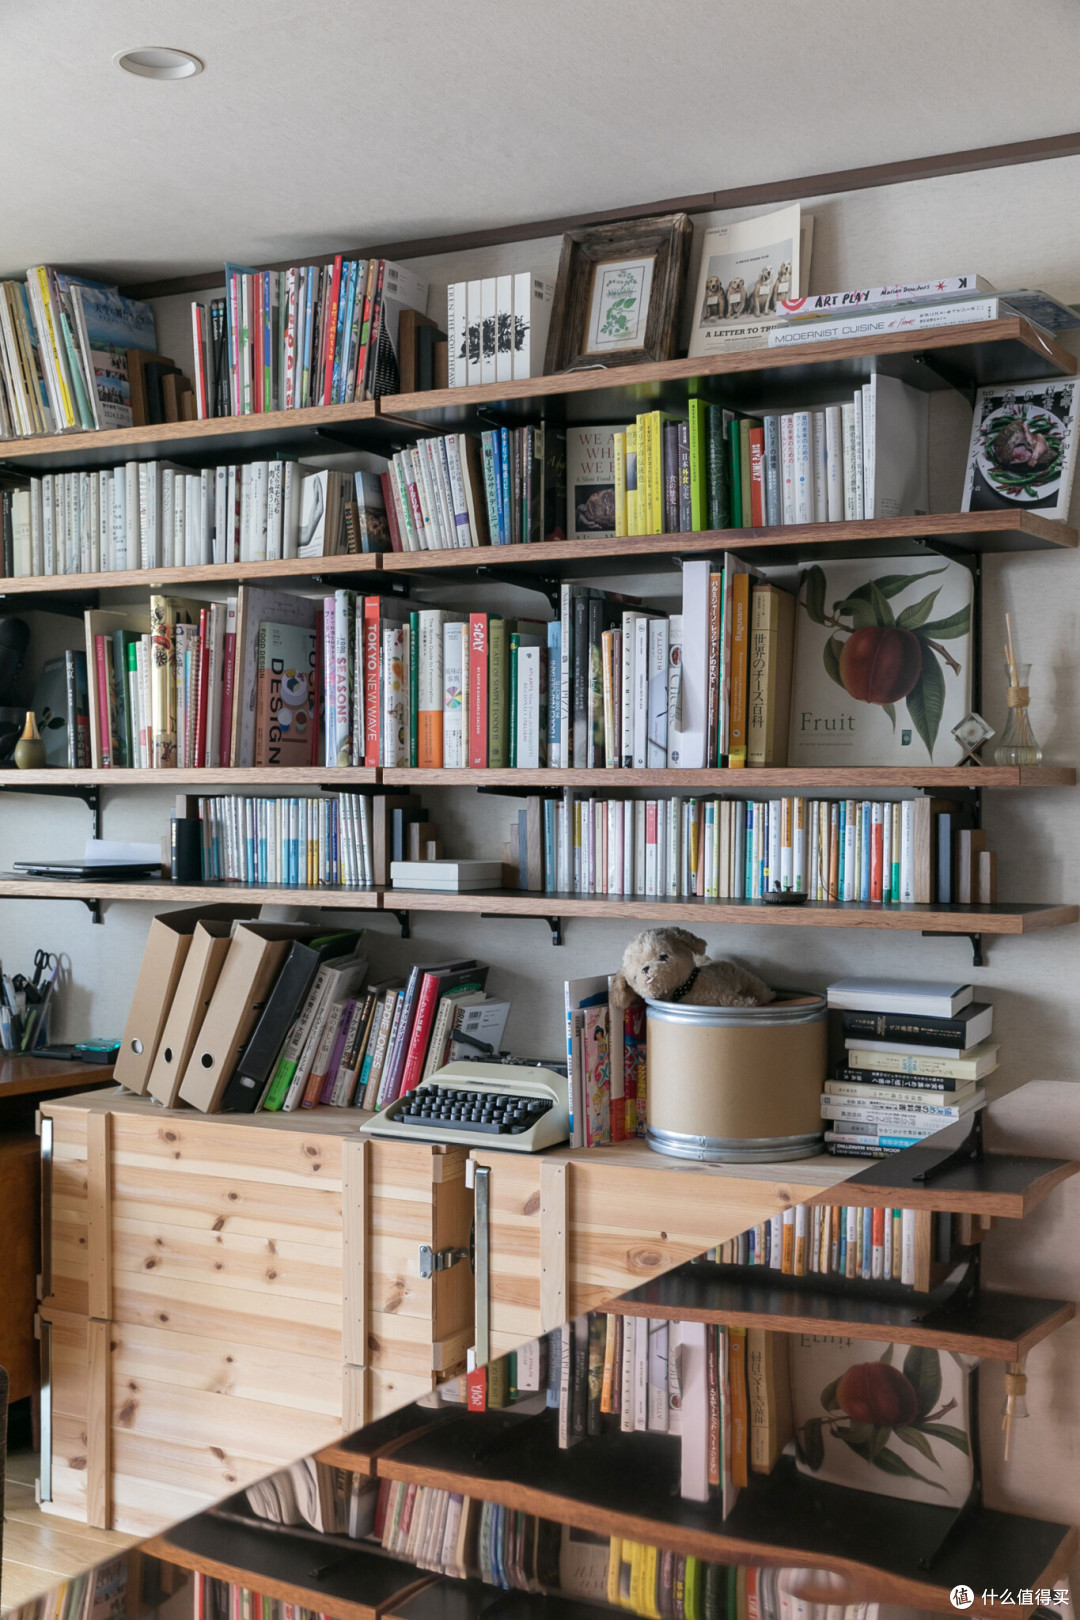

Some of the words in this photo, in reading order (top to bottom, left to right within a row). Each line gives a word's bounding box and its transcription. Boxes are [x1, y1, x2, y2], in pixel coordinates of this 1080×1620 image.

[814, 295, 837, 308] ART
[842, 290, 870, 306] PLAY
[713, 328, 745, 338] LETTER
[747, 326, 759, 334] TO
[775, 328, 839, 344] MODERNIST
[842, 321, 885, 335] CUISINE
[448, 333, 456, 387] SOUTHPAW
[580, 433, 602, 446] WE
[752, 443, 761, 462] PARIS
[581, 461, 604, 474] WE
[669, 474, 677, 505] 食の歴史
[473, 622, 484, 652] SICILY
[735, 602, 743, 642] Ragusano
[368, 624, 377, 671] TOKYO
[367, 674, 377, 695] NEW
[493, 667, 499, 677] OF
[751, 633, 767, 728] 世界のチーズ百科
[337, 658, 347, 724] SEASONS
[268, 658, 284, 765] DESIGN
[367, 697, 377, 741] WAVE
[800, 711, 856, 731] Fruit
[380, 995, 394, 1031] EDDIE
[372, 1034, 387, 1070] JONES
